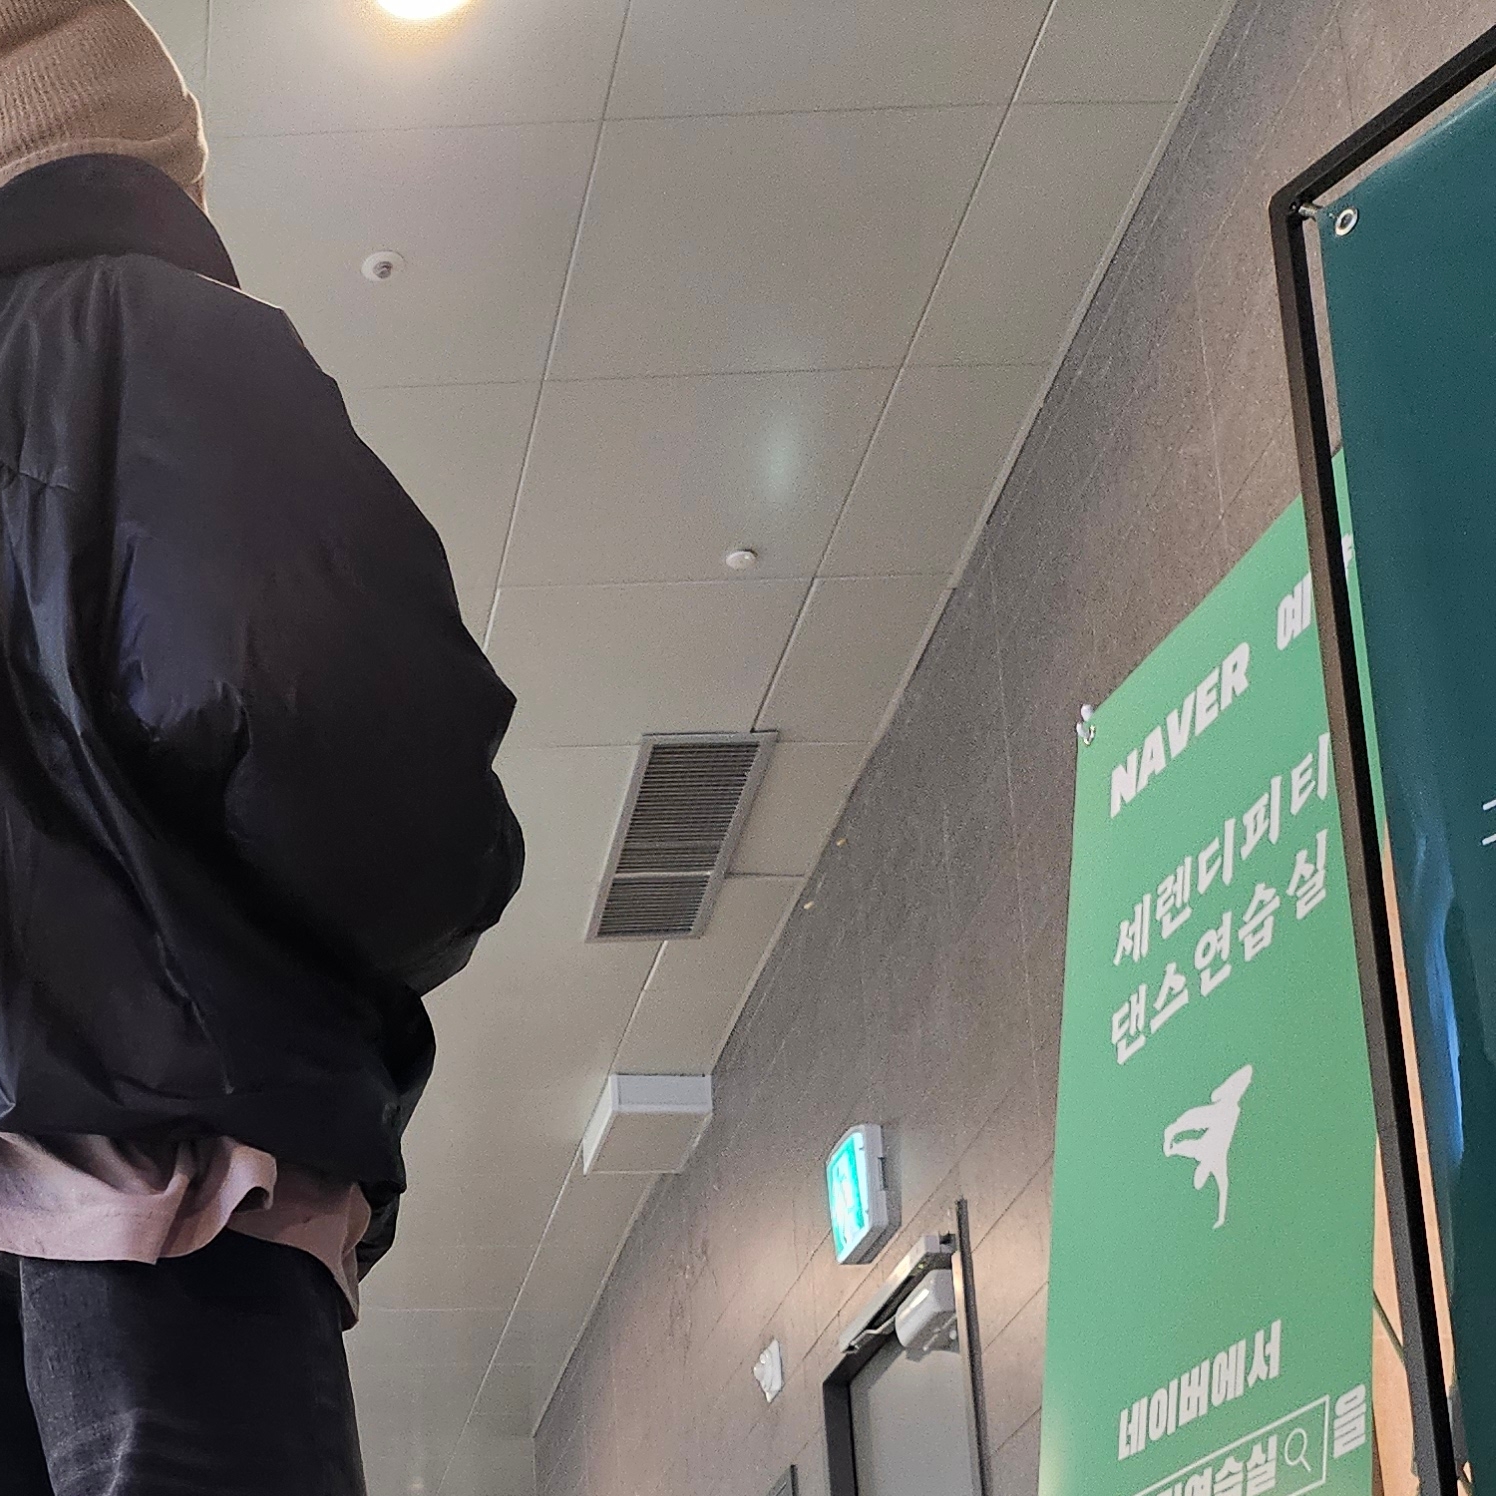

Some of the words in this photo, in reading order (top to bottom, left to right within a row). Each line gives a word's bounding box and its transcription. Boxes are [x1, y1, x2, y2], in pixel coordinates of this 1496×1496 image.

[1109, 641, 1251, 819] NAVER
[1113, 731, 1331, 967] 세렌디피티
[1110, 828, 1330, 1066] 댄스연습실
[1117, 1318, 1282, 1461] 네이버에서
[1333, 1384, 1367, 1460] 을
